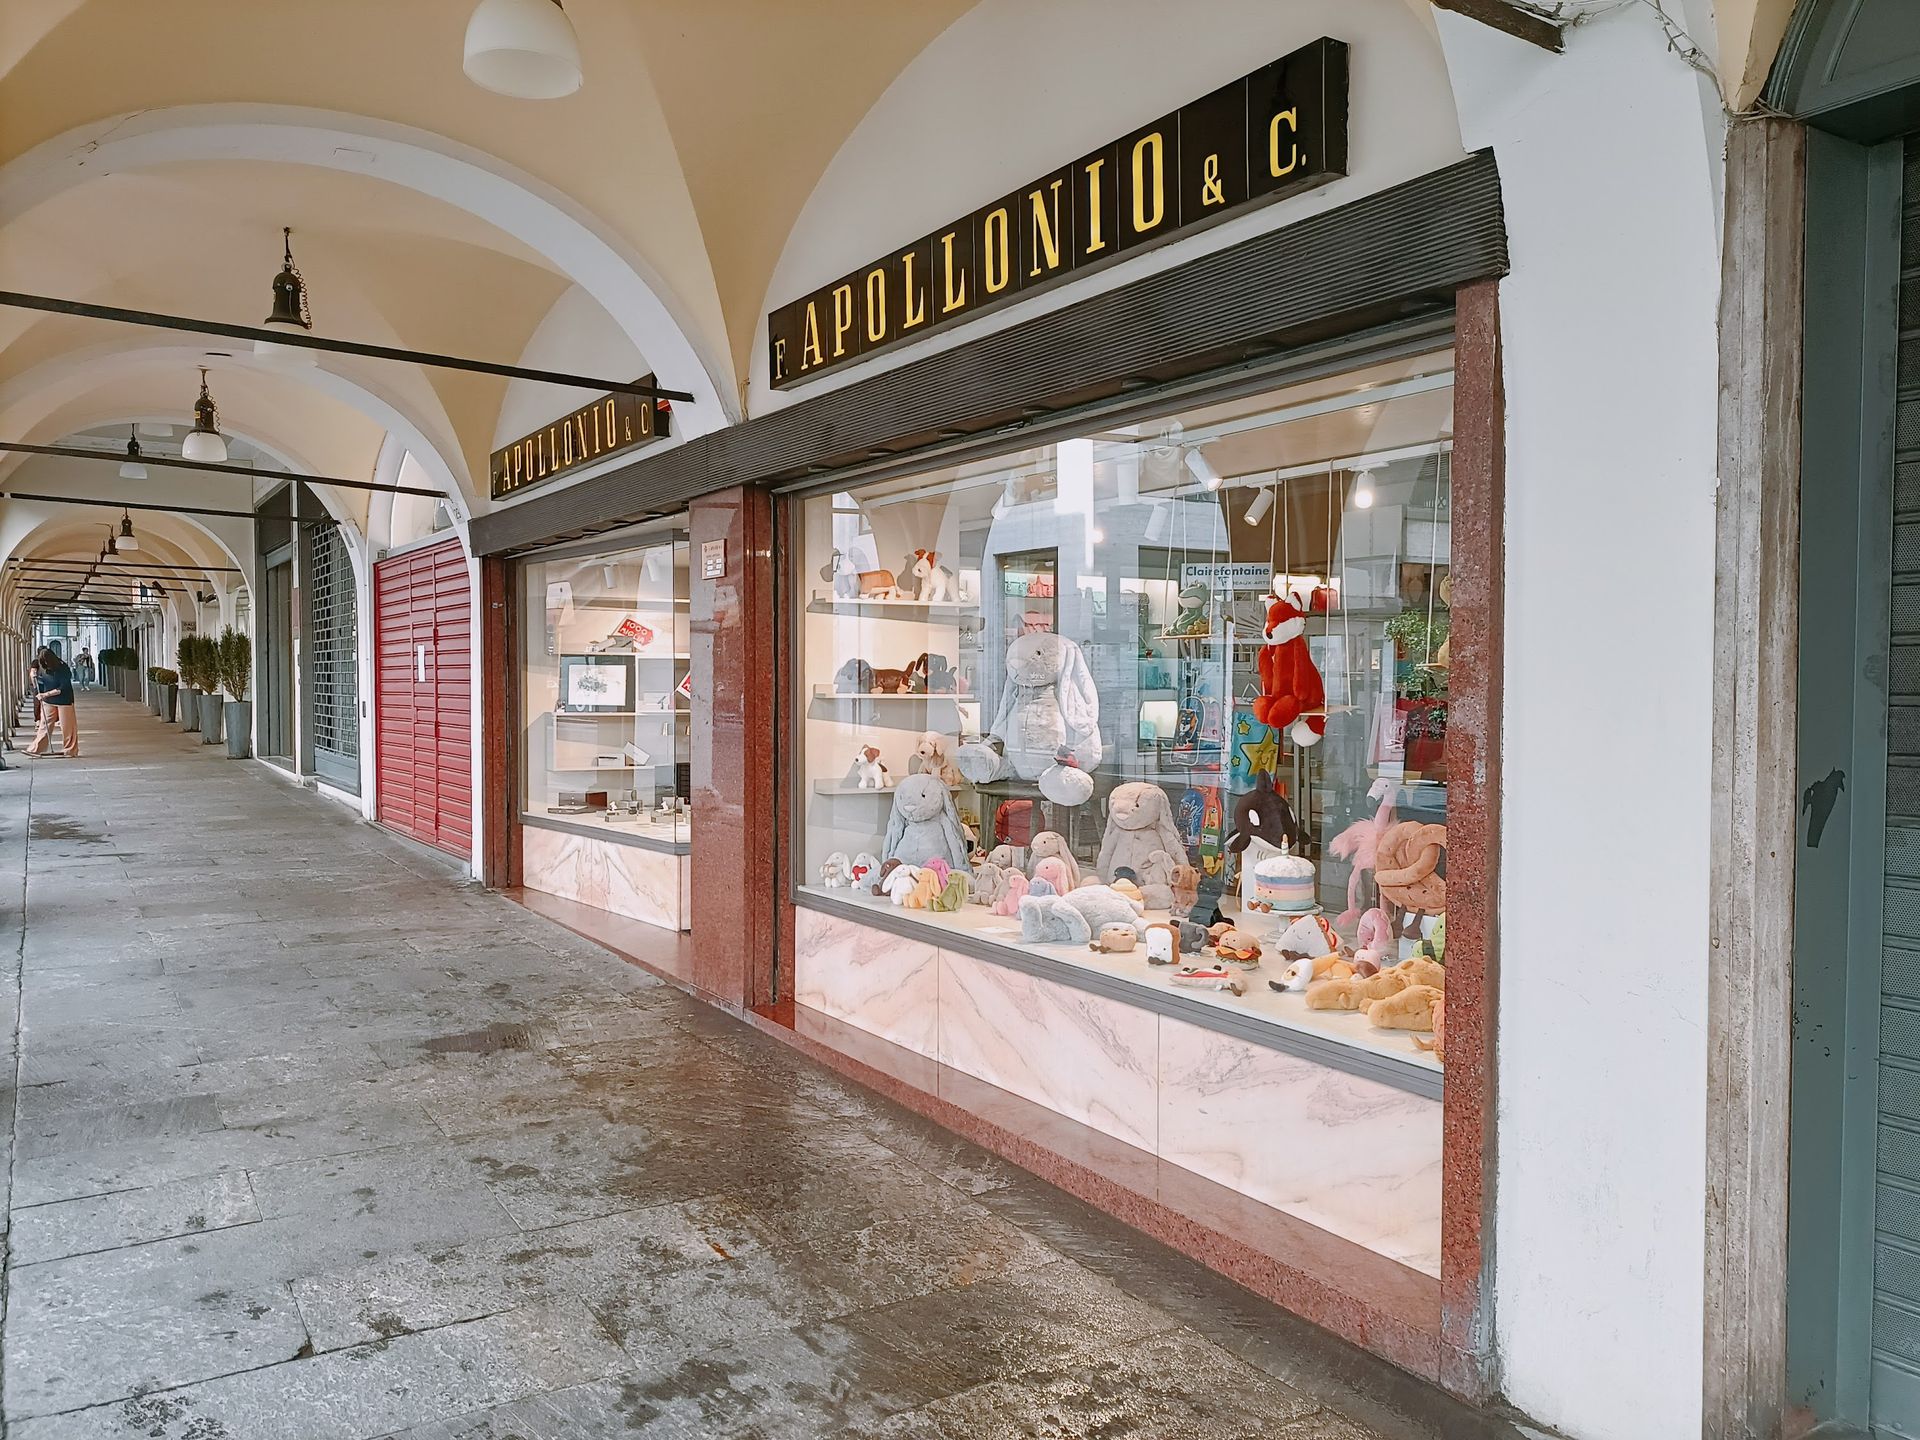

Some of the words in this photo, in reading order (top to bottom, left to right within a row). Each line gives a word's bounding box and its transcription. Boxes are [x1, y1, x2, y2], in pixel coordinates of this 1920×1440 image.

[774, 338, 788, 380] F.
[801, 132, 1164, 370] APOLLONIO
[1202, 154, 1225, 206] &
[1269, 107, 1307, 178] C.
[503, 399, 616, 491] APOLLONIO
[624, 416, 632, 441] &
[1186, 566, 1270, 576] Clairefontaine
[626, 621, 648, 636] 1000
